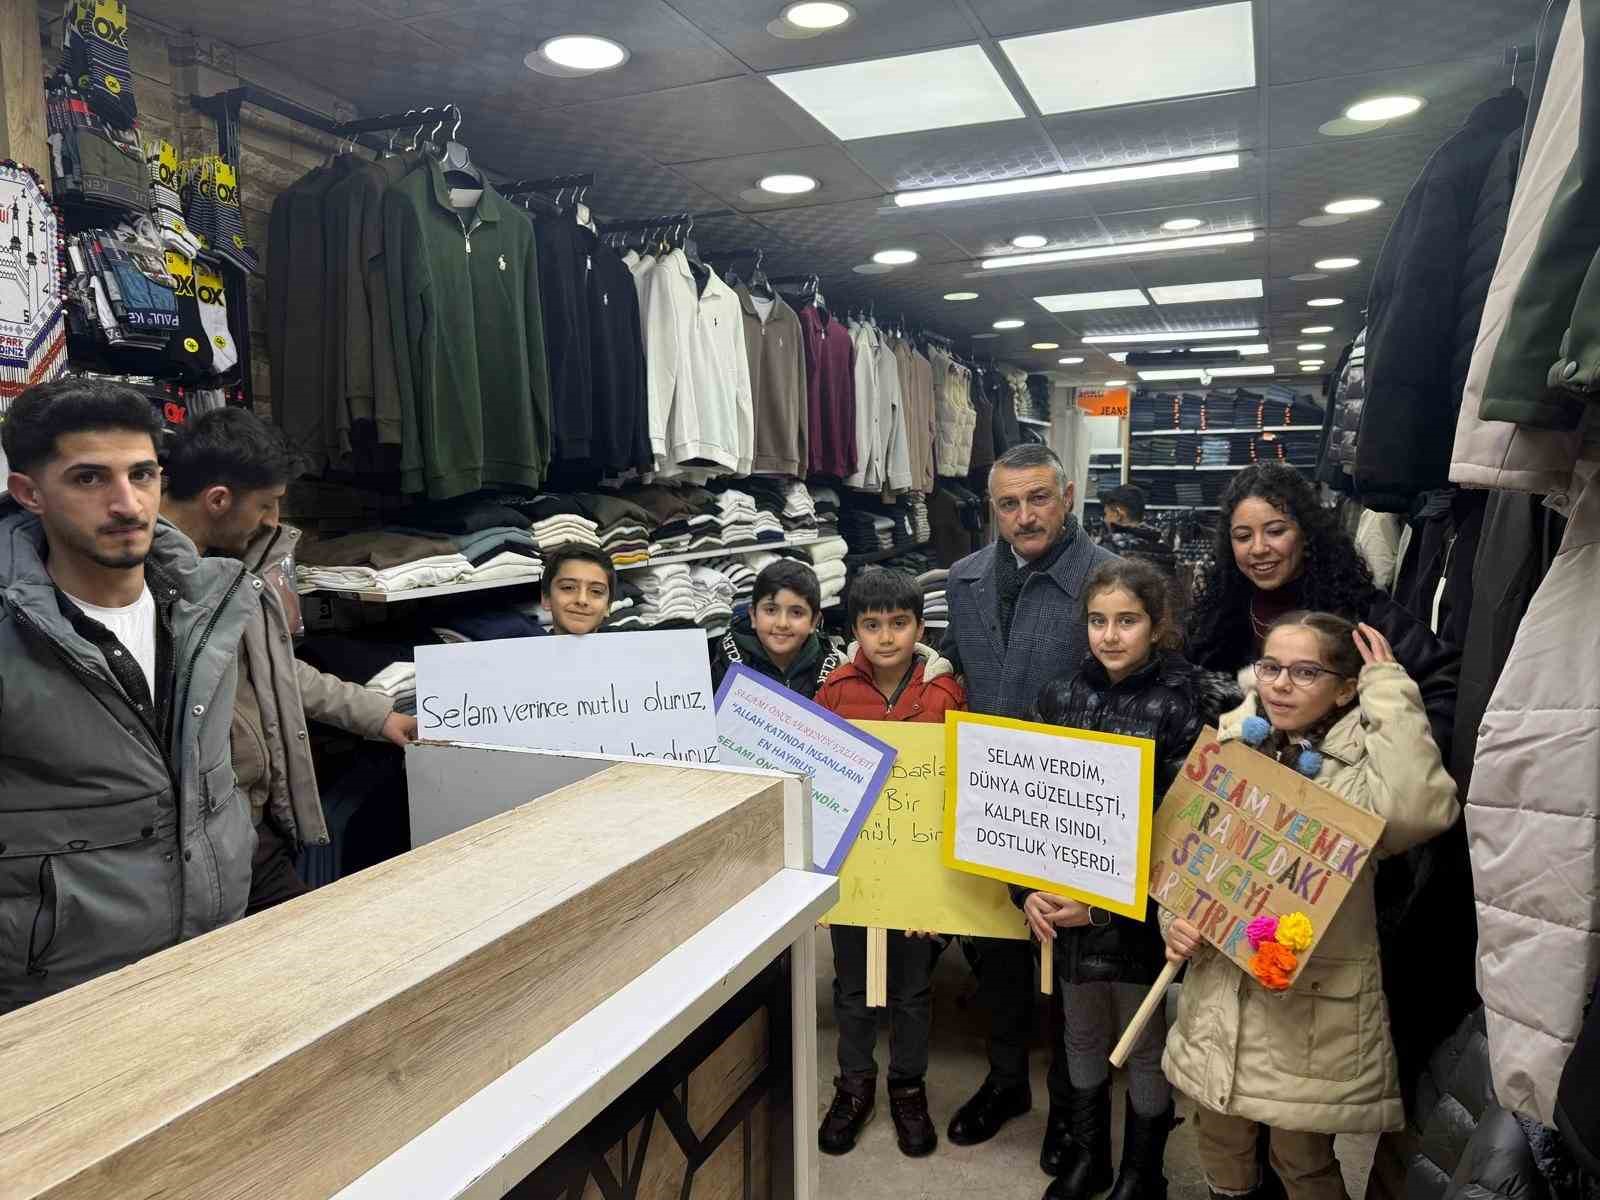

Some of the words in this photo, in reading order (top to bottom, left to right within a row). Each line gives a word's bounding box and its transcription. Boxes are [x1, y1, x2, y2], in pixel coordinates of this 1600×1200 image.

[197, 285, 225, 307] OX
[1101, 405, 1129, 417] JEANS
[422, 692, 498, 729] Selam
[503, 699, 569, 723] verince
[577, 682, 629, 716] mutlu
[643, 680, 706, 713] oluruz,
[716, 735, 756, 761] SELAMI
[757, 737, 772, 752] EN
[765, 721, 806, 752] KATINDA
[805, 743, 865, 785] İNSANLARIN
[987, 747, 1035, 770] SELAM
[1039, 756, 1105, 786] VERDİM,
[885, 788, 921, 811] Bir
[969, 770, 1020, 795] DÜNYA
[1024, 780, 1126, 821] GÜZELLEŞTİ,
[1184, 742, 1272, 820] SELAM
[1272, 802, 1368, 883] VERMEK
[984, 801, 1050, 830] KALPLER
[1055, 816, 1107, 846] ISINDI,
[976, 827, 1046, 857] DOSTLUK
[1051, 843, 1121, 877] YEŞERDİ.
[1177, 794, 1332, 905] ARANIZDAKİ
[1171, 832, 1274, 917] SEVGİYİ
